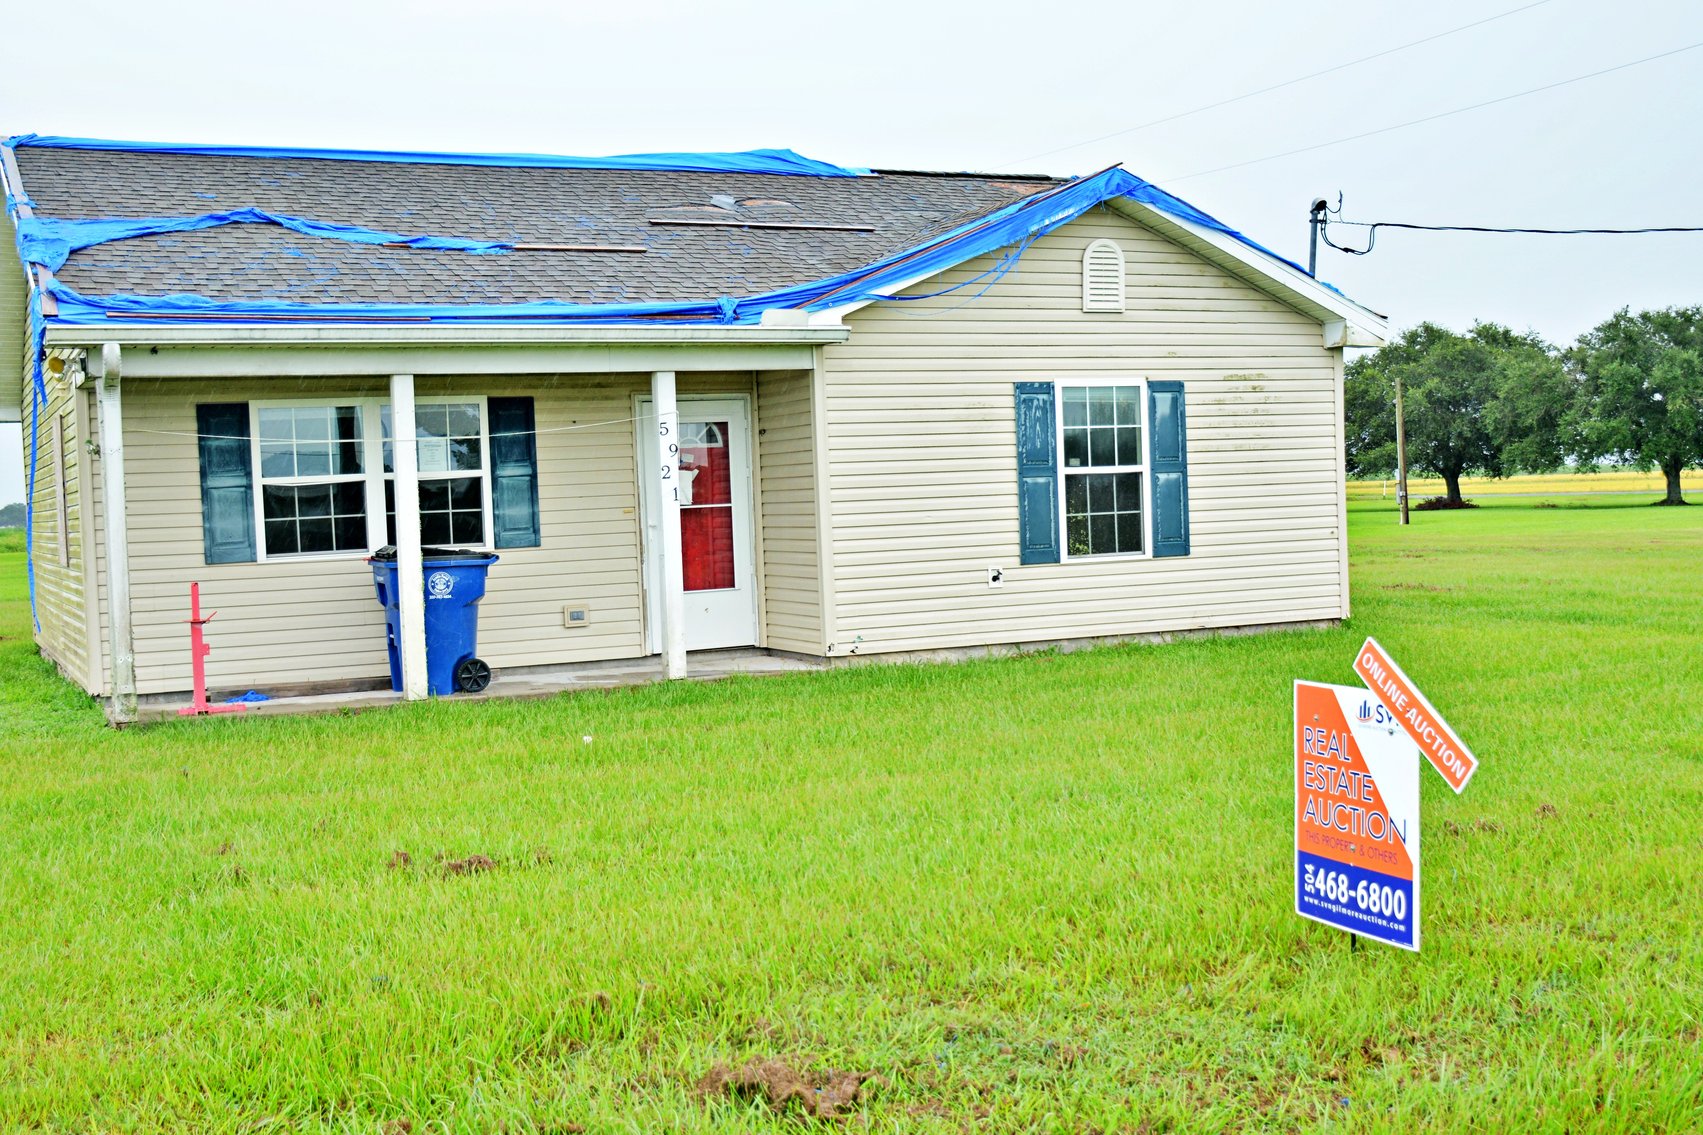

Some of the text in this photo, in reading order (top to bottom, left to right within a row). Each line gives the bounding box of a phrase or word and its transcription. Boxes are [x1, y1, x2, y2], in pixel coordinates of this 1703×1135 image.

[1361, 653, 1408, 712] ONLINE
[1405, 708, 1466, 780] AUCTION
[1303, 726, 1352, 762] REAL
[1304, 761, 1374, 803] ESTATE
[1302, 794, 1407, 845] AUCTION
[1305, 830, 1320, 844] THIS
[1360, 844, 1365, 857] &
[1367, 846, 1398, 865] OTHERS
[1304, 863, 1407, 920] 504 468-6800
